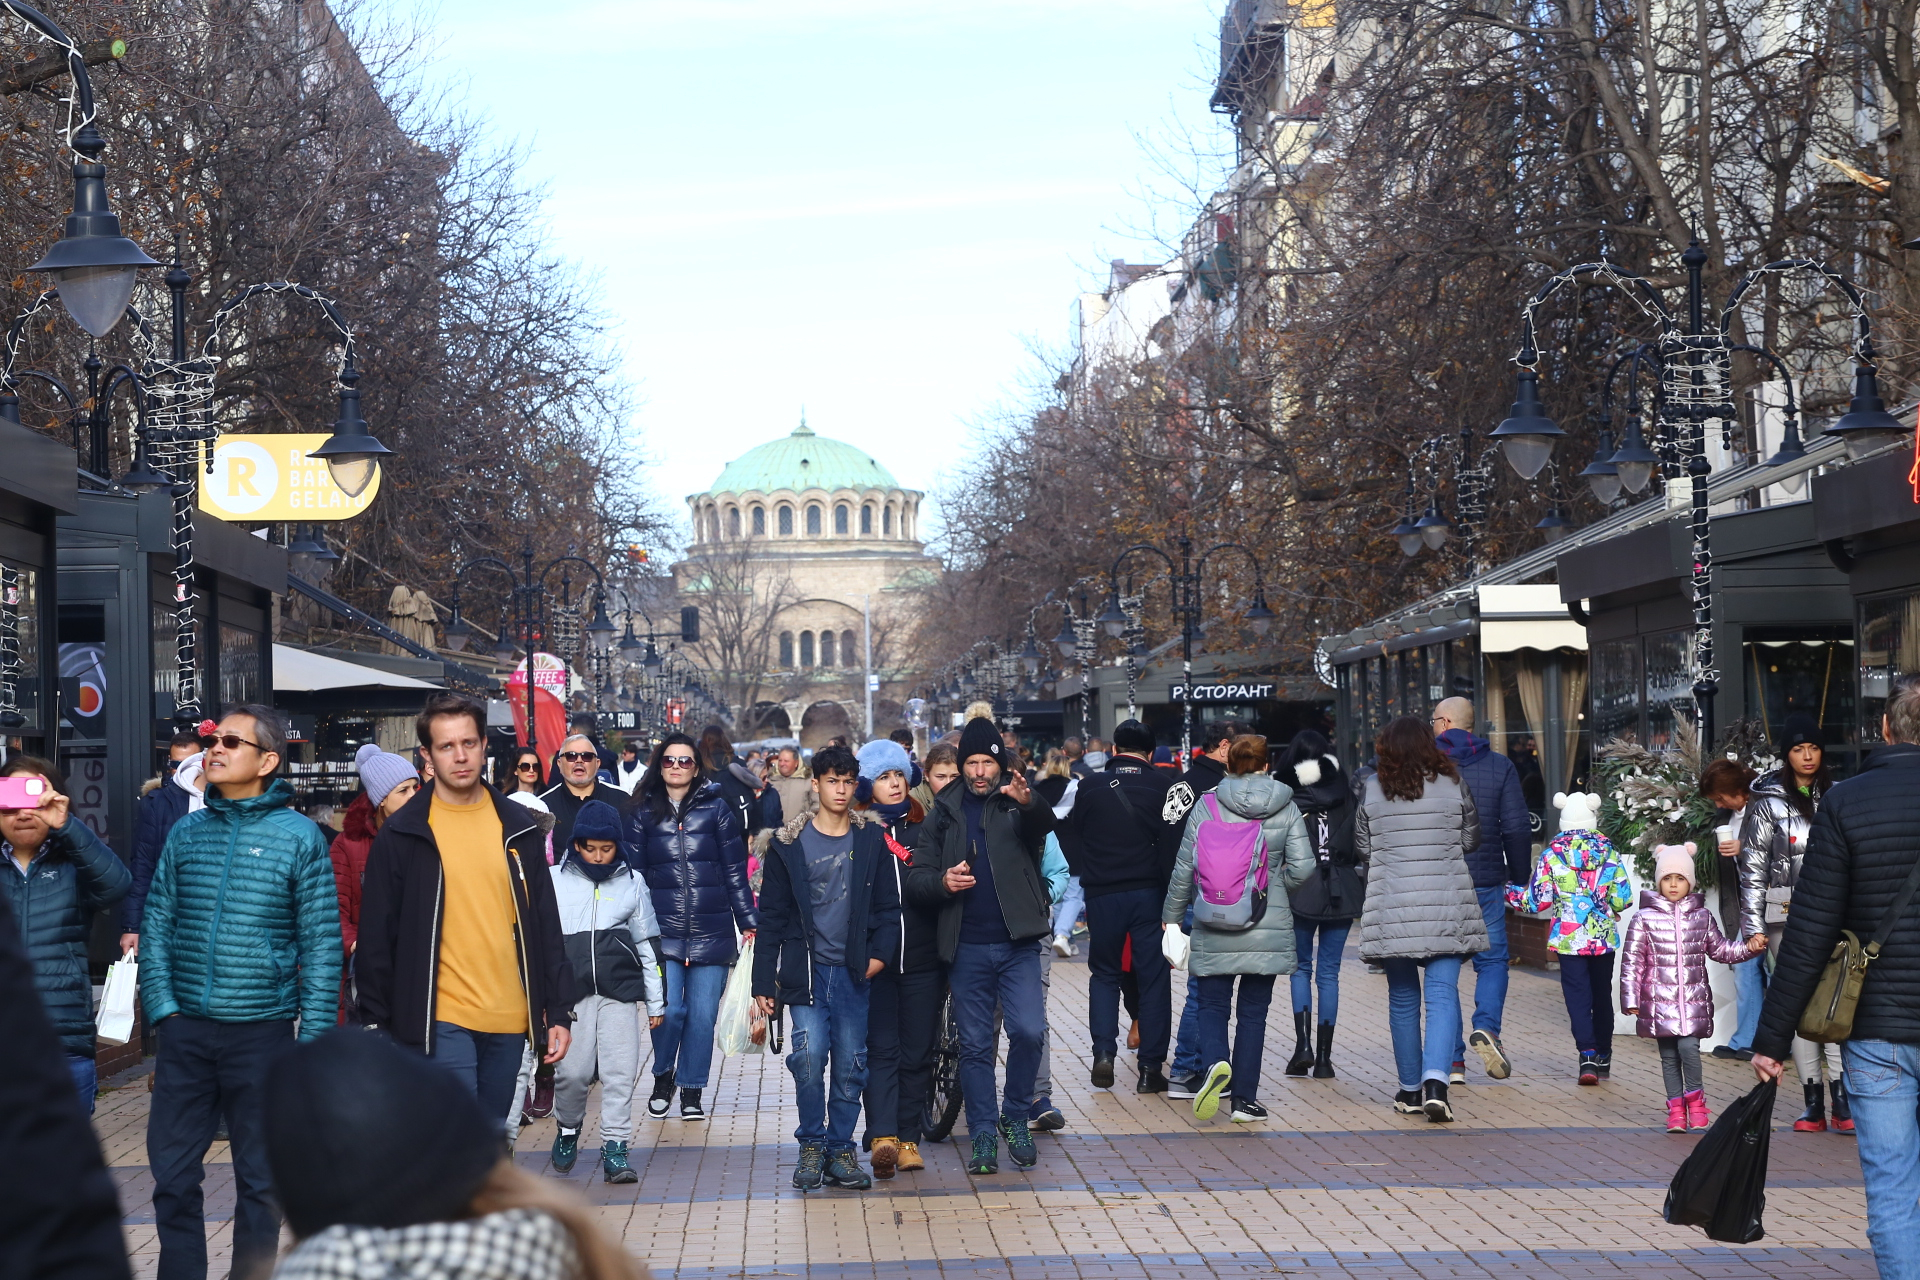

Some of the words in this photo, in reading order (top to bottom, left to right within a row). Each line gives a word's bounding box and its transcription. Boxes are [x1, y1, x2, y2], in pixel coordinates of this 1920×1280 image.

[227, 457, 261, 496] R
[290, 470, 328, 487] BAR
[522, 671, 558, 684] CFFEE
[1173, 685, 1272, 699] РСТОРАНТ
[617, 712, 635, 728] FOOD
